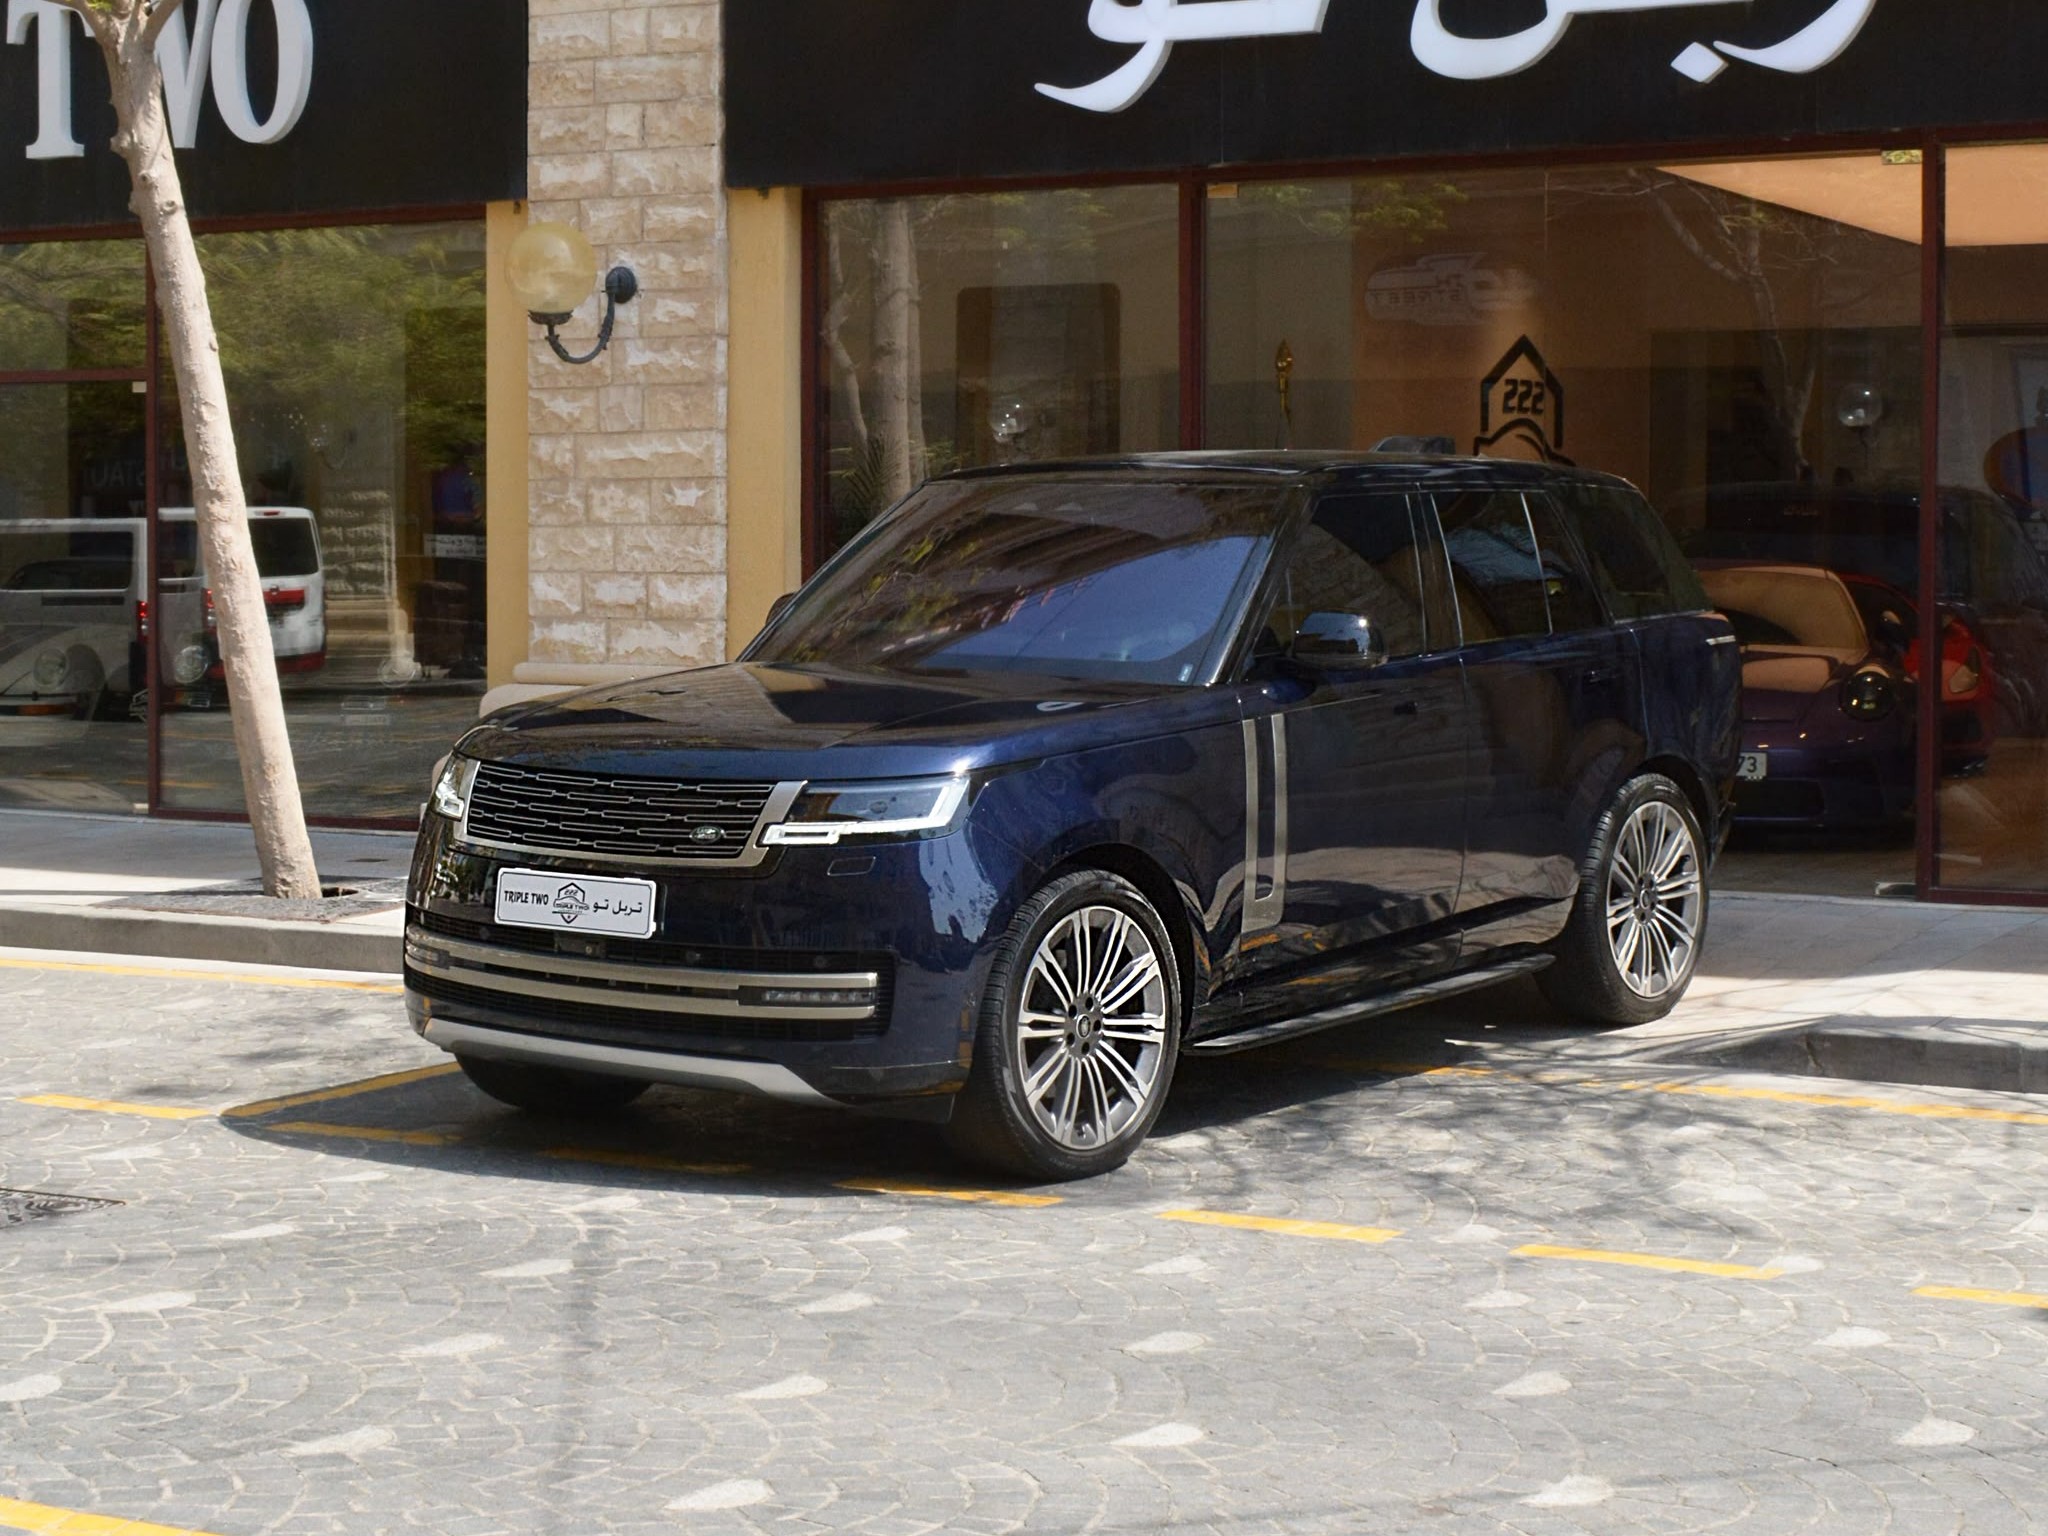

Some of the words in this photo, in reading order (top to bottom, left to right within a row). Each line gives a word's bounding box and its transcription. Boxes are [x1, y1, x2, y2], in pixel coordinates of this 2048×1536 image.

[1502, 378, 1545, 415] 222
[504, 890, 529, 904] TRIPLE
[531, 893, 549, 906] TWO
[593, 899, 609, 913] تو
